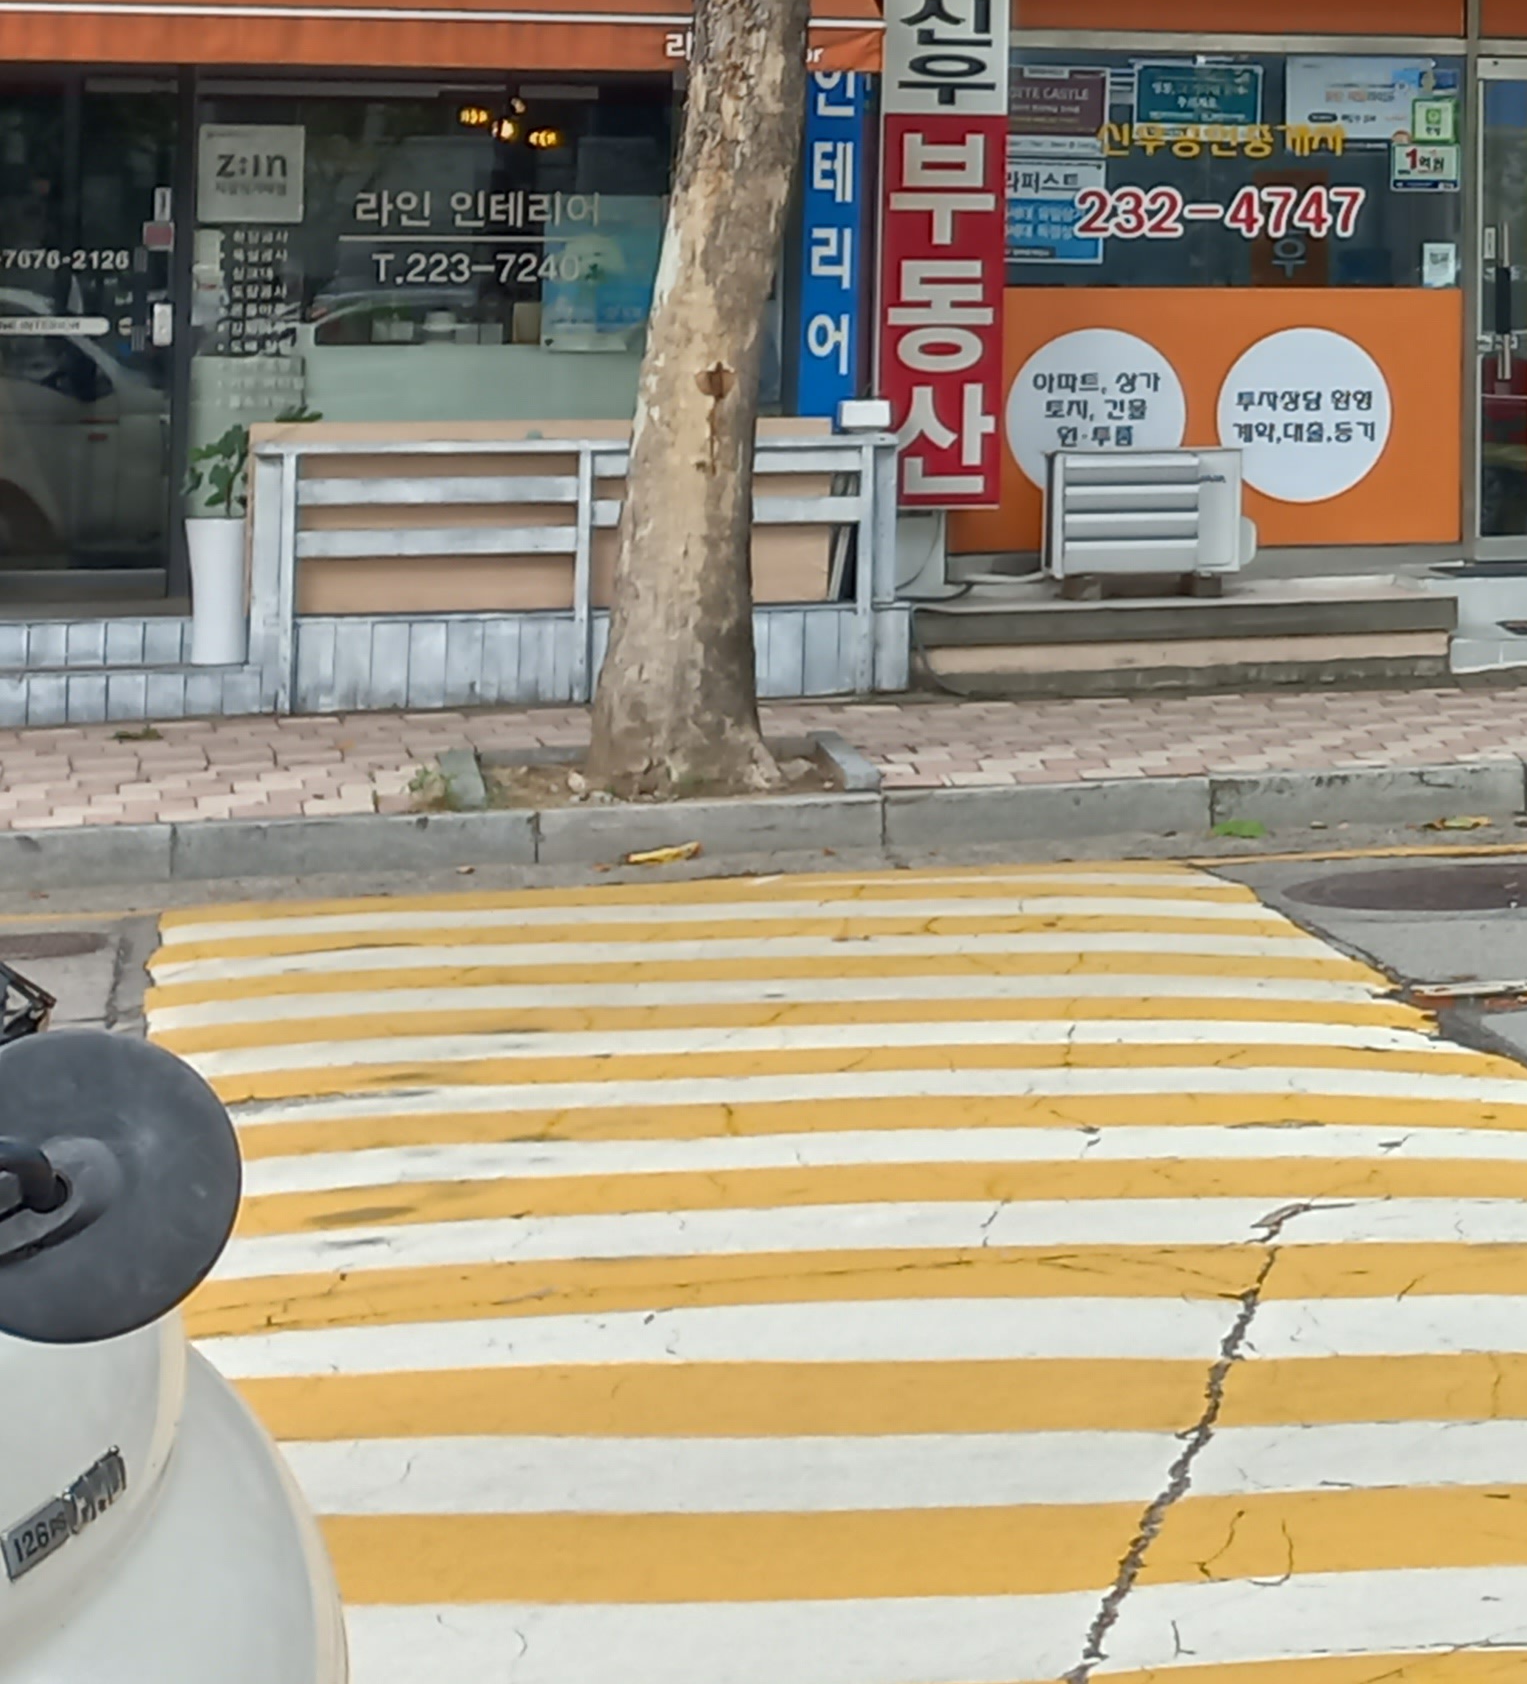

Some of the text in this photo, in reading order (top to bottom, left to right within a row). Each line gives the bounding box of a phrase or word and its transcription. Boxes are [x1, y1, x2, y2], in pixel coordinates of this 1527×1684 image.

[356, 190, 601, 228] 라인 인테리어
[1075, 187, 1366, 238] 232-4747
[887, 132, 996, 496] 부동산
